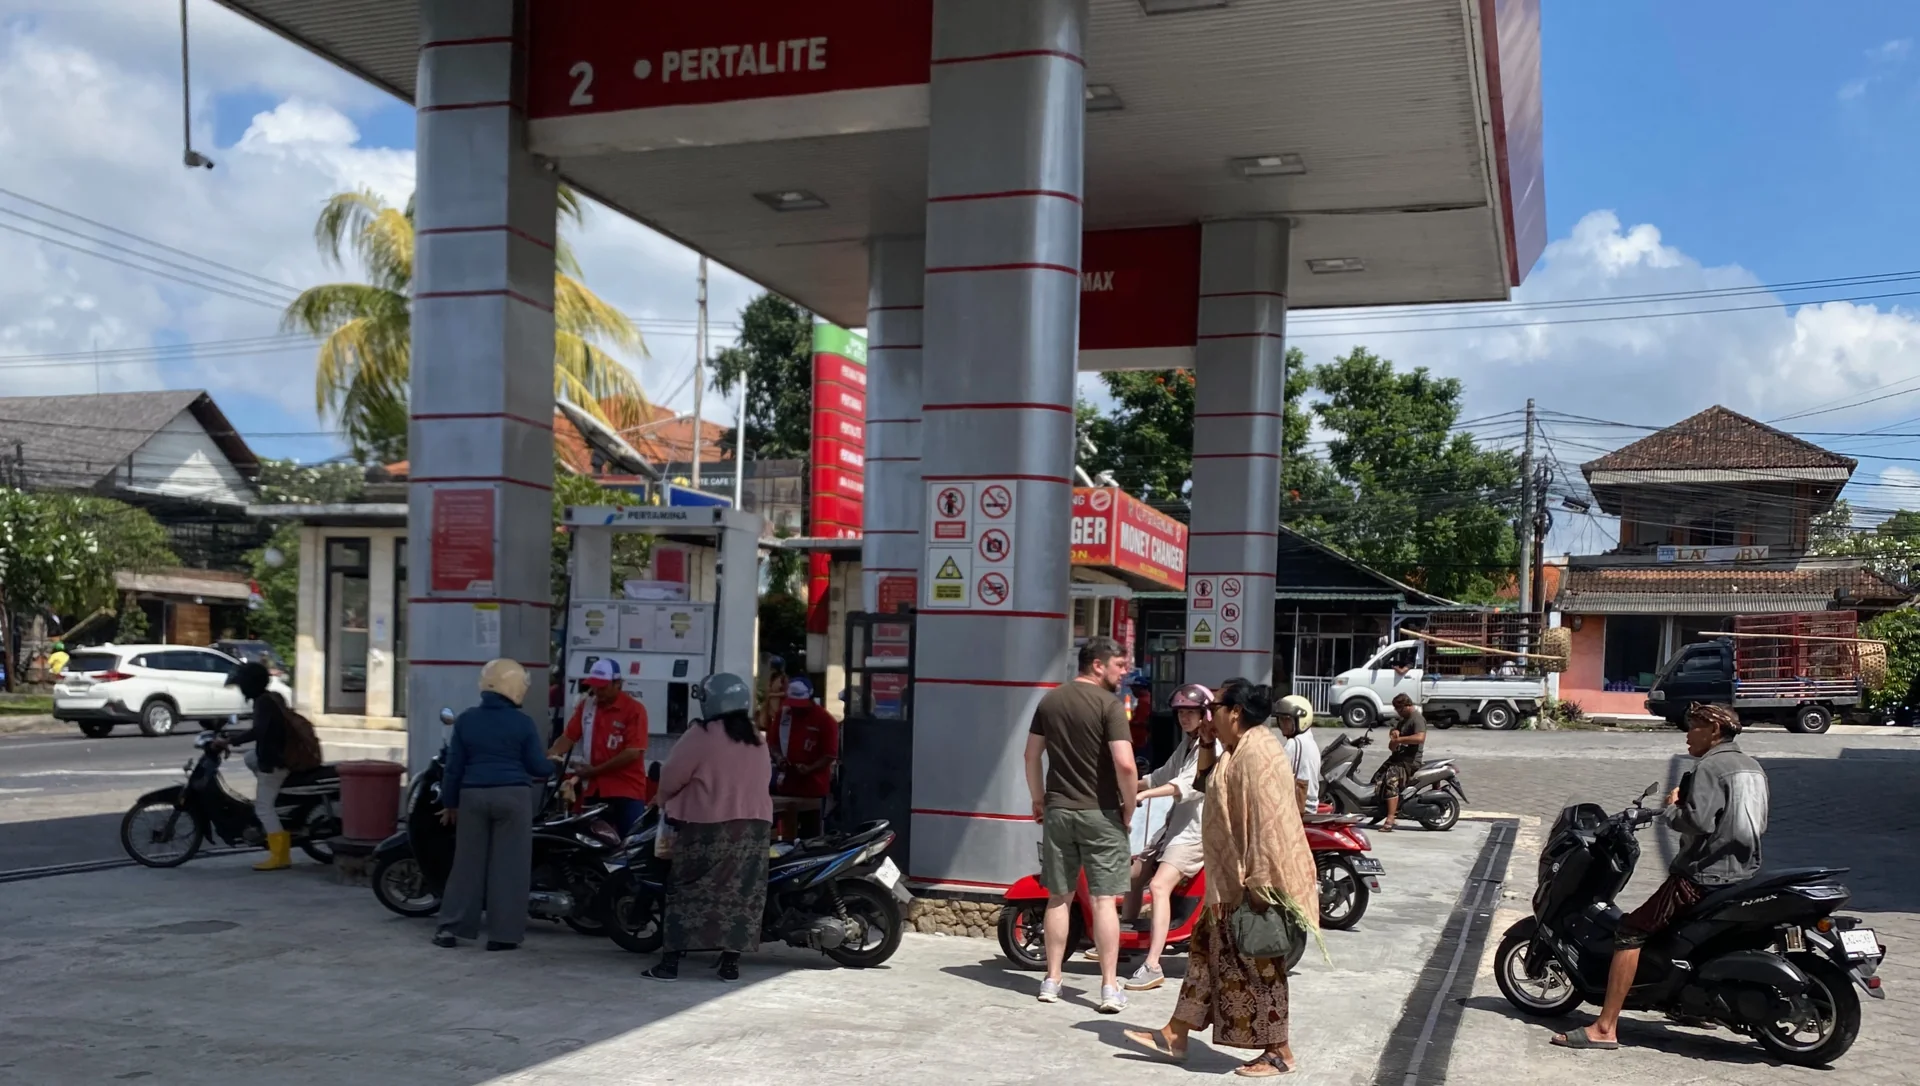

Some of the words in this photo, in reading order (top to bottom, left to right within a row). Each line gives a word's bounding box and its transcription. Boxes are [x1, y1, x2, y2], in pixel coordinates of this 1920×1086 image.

[569, 61, 593, 106] 2
[662, 37, 827, 83] PERTALITE
[710, 477, 729, 486] CAFE
[1120, 521, 1150, 559] MONEY
[1151, 536, 1184, 573] CHANGER
[568, 680, 577, 694] 7
